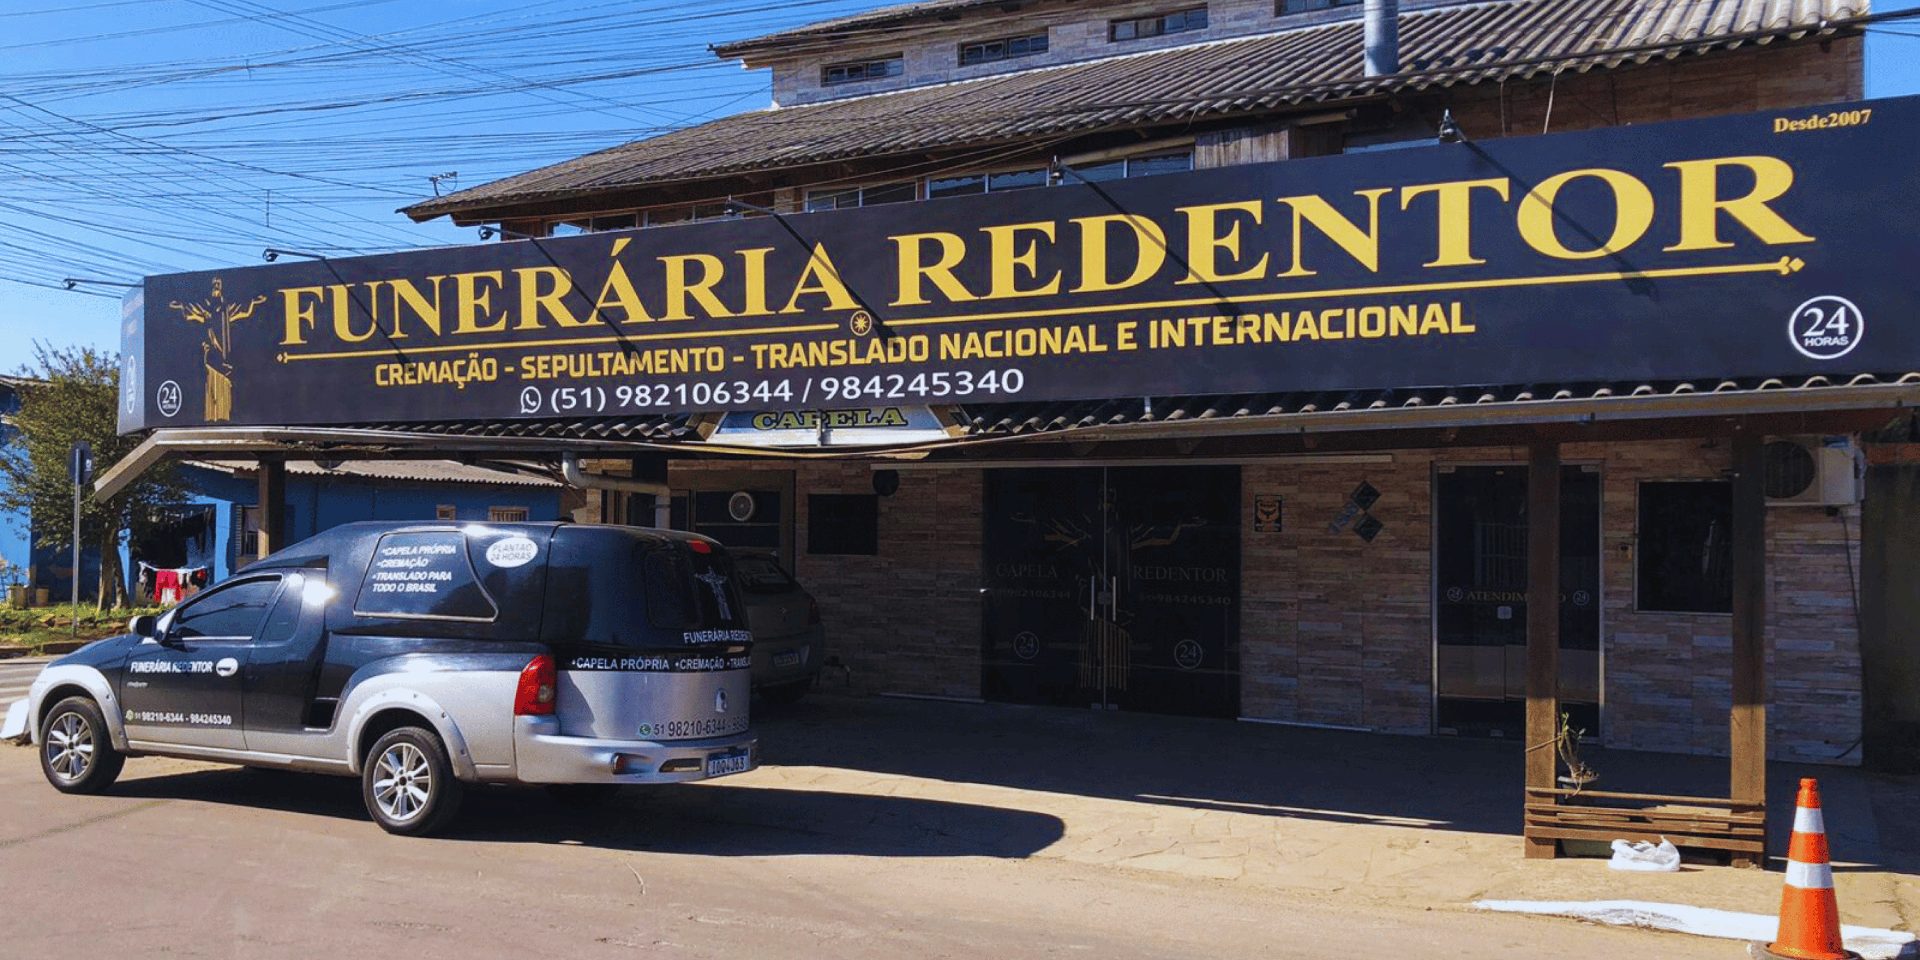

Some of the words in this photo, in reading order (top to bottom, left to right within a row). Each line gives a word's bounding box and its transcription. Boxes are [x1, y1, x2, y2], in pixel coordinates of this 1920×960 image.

[1773, 108, 1872, 134] Desde2007
[278, 238, 862, 346] FUNERÁRIA
[887, 155, 1815, 307] REDENTOR
[1803, 306, 1849, 336] 24
[375, 352, 498, 389] CREMAÇÃO
[504, 366, 514, 374] -
[521, 347, 725, 380] SEPULTAMENTO
[751, 334, 929, 370] TRANSLADO
[940, 324, 1107, 360] NACIONAL
[1117, 321, 1137, 351] E
[1149, 302, 1475, 349] INTERNACIONAL
[1804, 335, 1849, 348] HORAS
[162, 387, 177, 403] 24
[550, 386, 606, 413] (51)
[615, 379, 793, 407] 982106344
[803, 377, 812, 403] /
[820, 368, 1024, 401] 984245340
[753, 407, 908, 430] CAPELA
[995, 563, 1057, 578] CAPELA
[1133, 565, 1228, 582] REDENTOR
[372, 583, 396, 593] TODO
[683, 628, 730, 643] FUNERÁRIA
[1179, 644, 1197, 658] 24
[130, 659, 171, 673] FUNERÁRIA
[620, 656, 669, 670] PRÓPRIA
[142, 711, 184, 722] 98210-6344
[190, 713, 232, 725] 984245340
[653, 723, 665, 735] 51
[668, 719, 726, 736] 98210-6344
